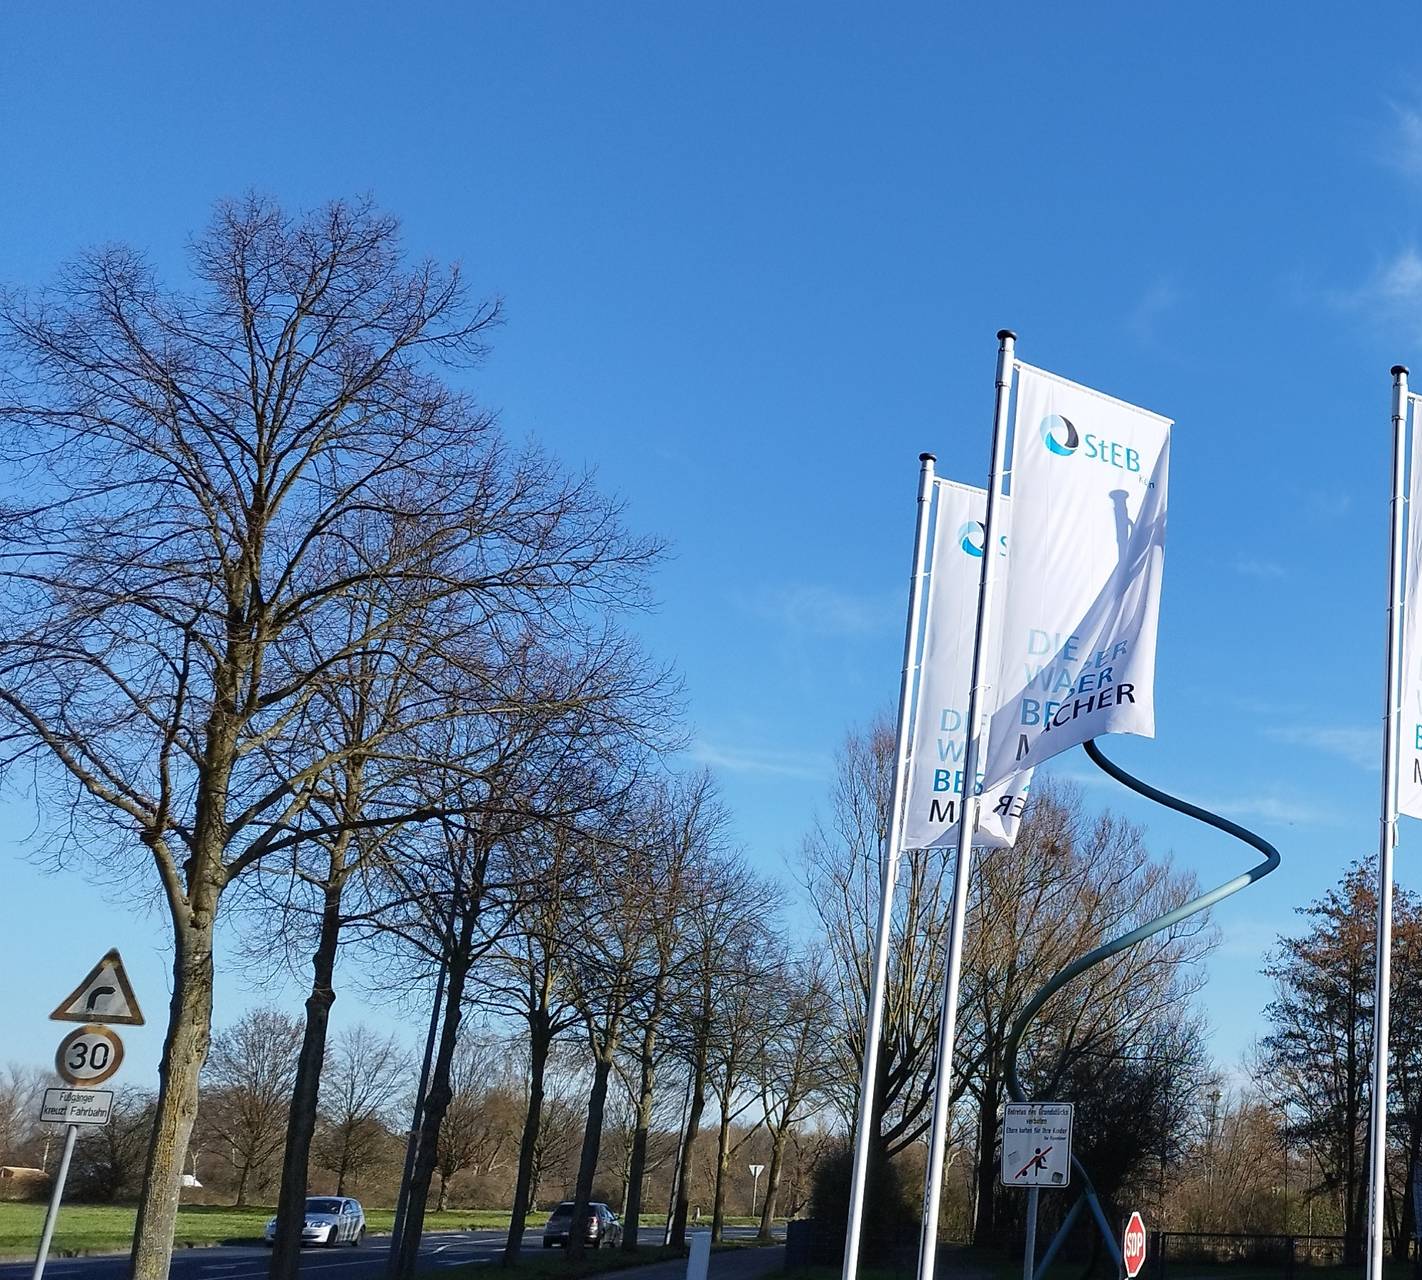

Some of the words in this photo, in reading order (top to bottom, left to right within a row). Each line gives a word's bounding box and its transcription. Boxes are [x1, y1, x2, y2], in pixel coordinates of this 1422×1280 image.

[1084, 433, 1140, 473] StEB
[1027, 629, 1080, 662] DIE
[69, 1042, 109, 1070] 30
[43, 1104, 67, 1116] kreuzt
[69, 1105, 108, 1118] Fahrbahn
[59, 1091, 95, 1105] Fußgänger
